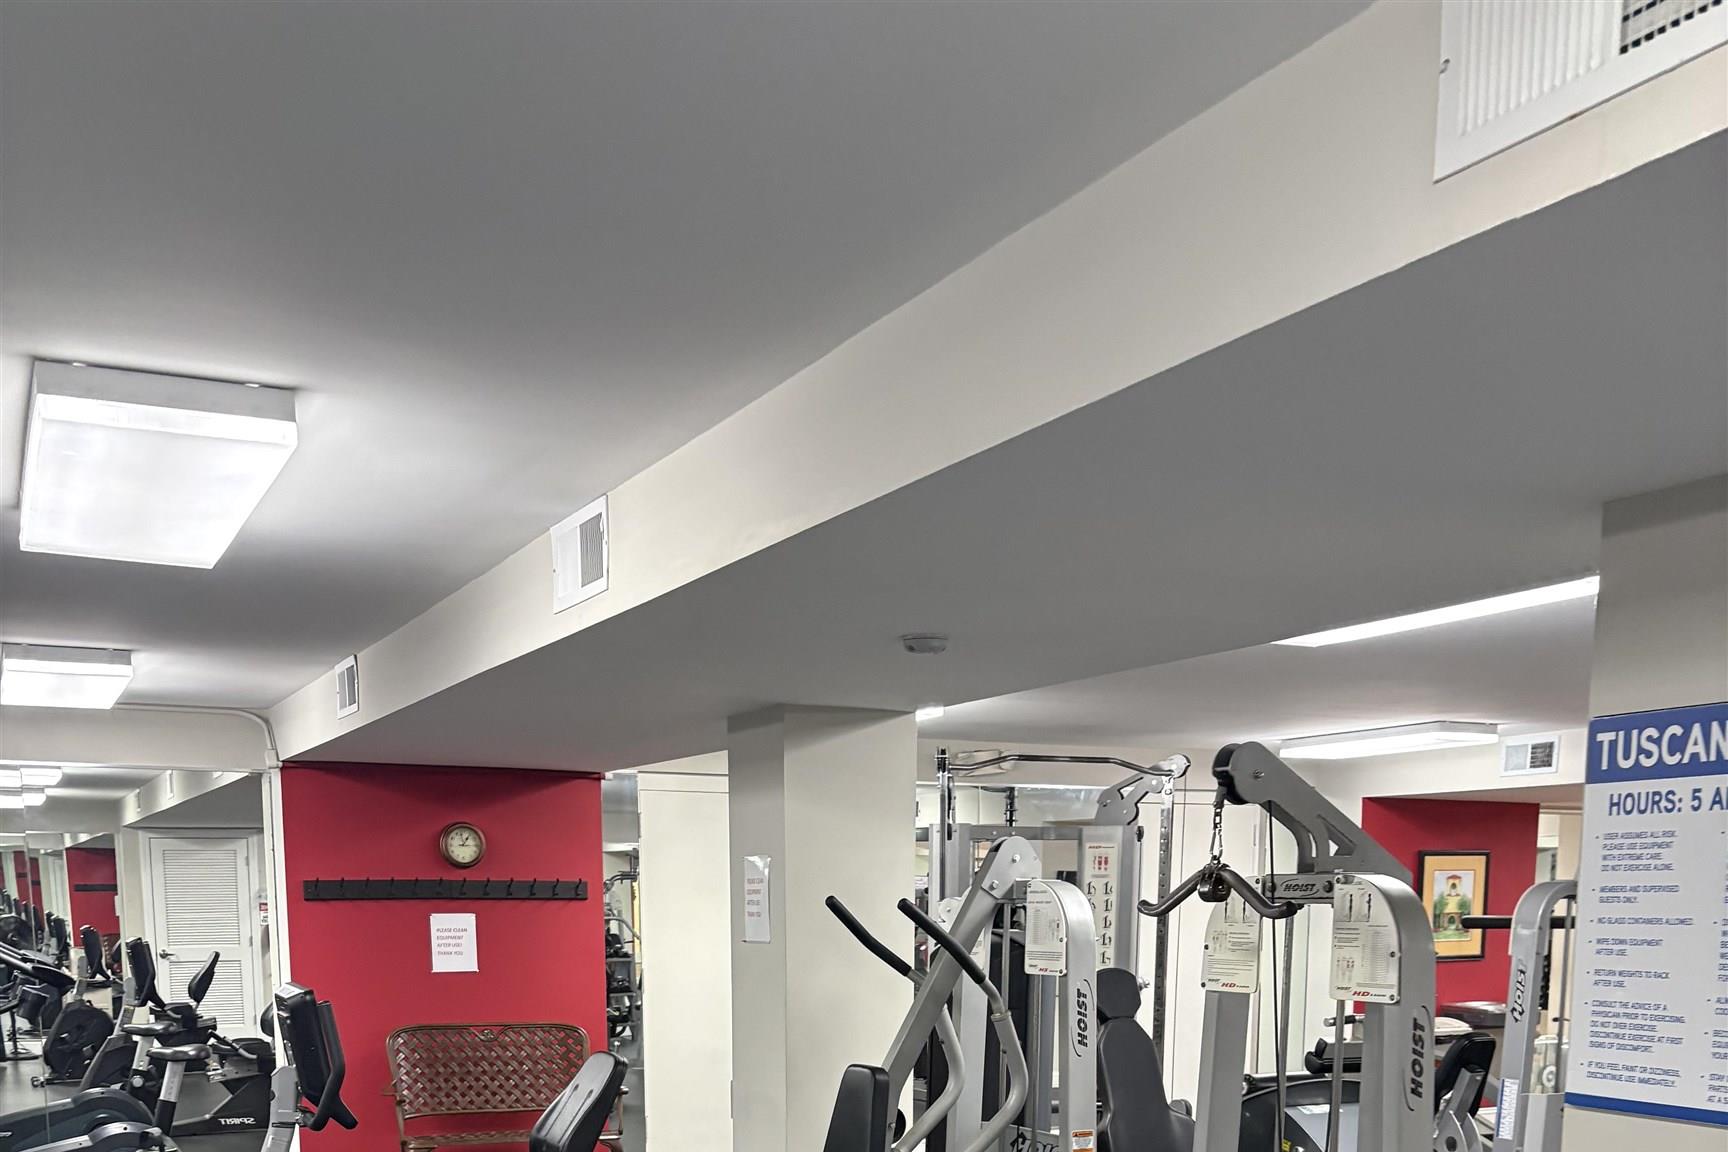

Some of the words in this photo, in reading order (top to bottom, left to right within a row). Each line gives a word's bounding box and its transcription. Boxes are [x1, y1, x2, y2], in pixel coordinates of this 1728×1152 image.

[1596, 720, 1728, 770] TUSCAN
[1608, 789, 1683, 816] HOURS:
[1691, 788, 1702, 812] 5
[1283, 883, 1316, 892] HOIST
[1076, 988, 1088, 1048] HOIST
[1410, 1017, 1425, 1099] HOIST
